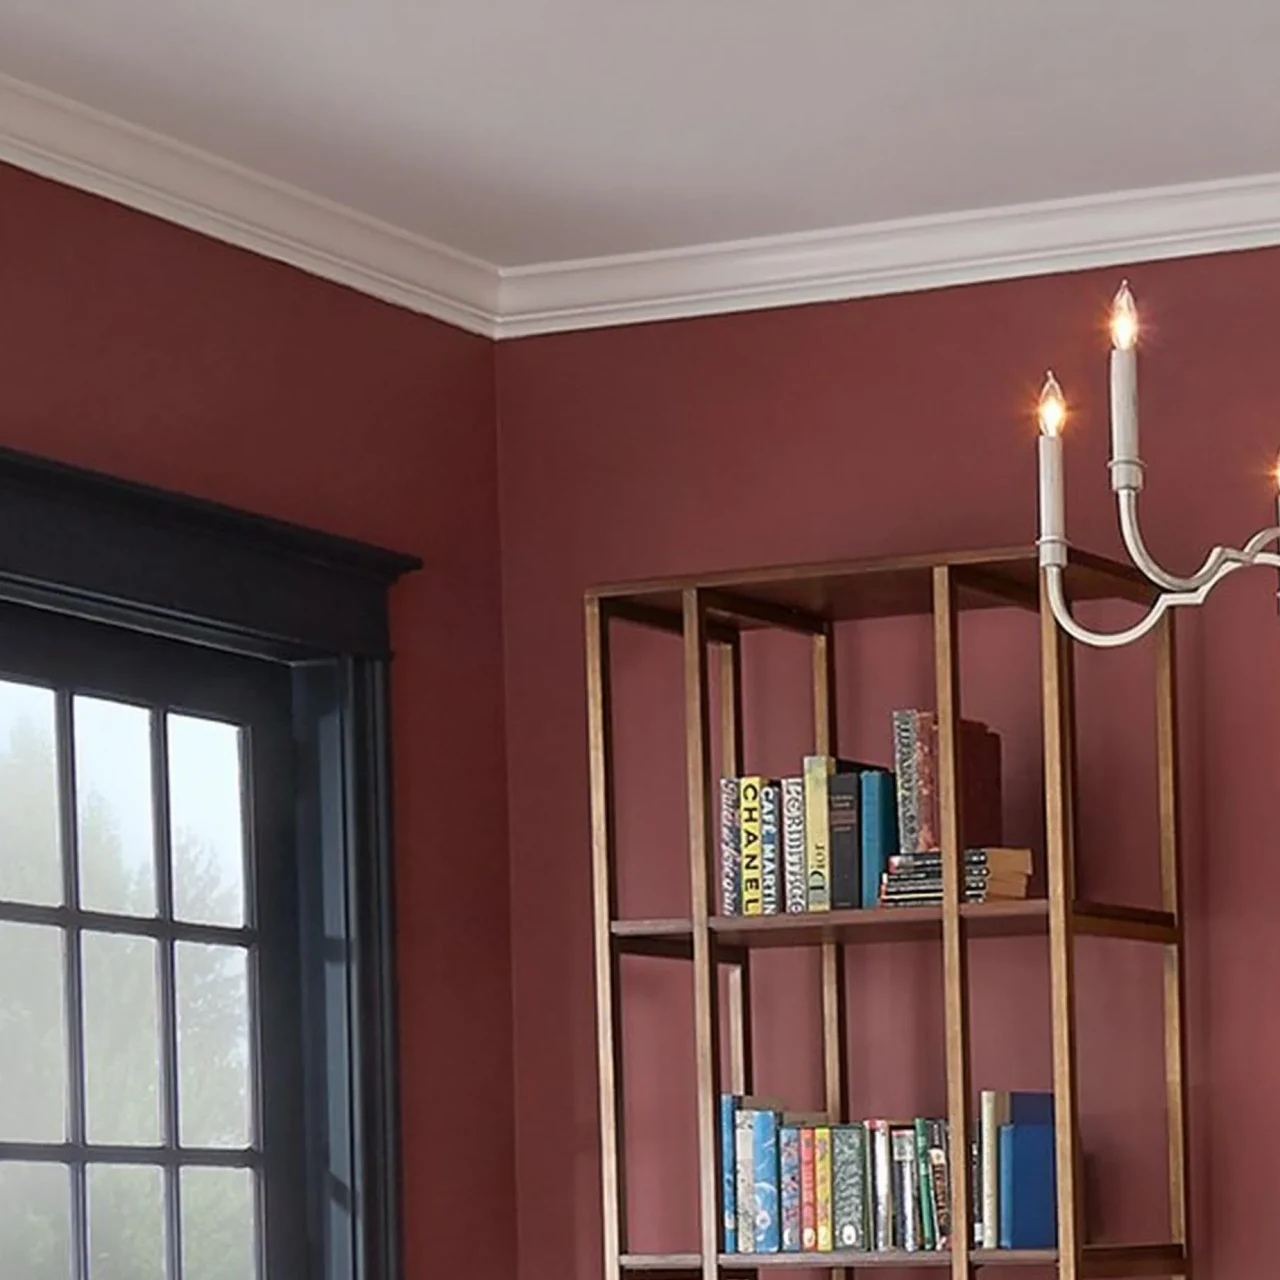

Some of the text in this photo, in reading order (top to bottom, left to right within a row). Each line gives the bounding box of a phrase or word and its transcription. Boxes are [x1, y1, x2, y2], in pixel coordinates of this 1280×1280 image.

[743, 783, 760, 913] CHANEL
[763, 842, 777, 915] MARTIN
[809, 844, 825, 890] Dior
